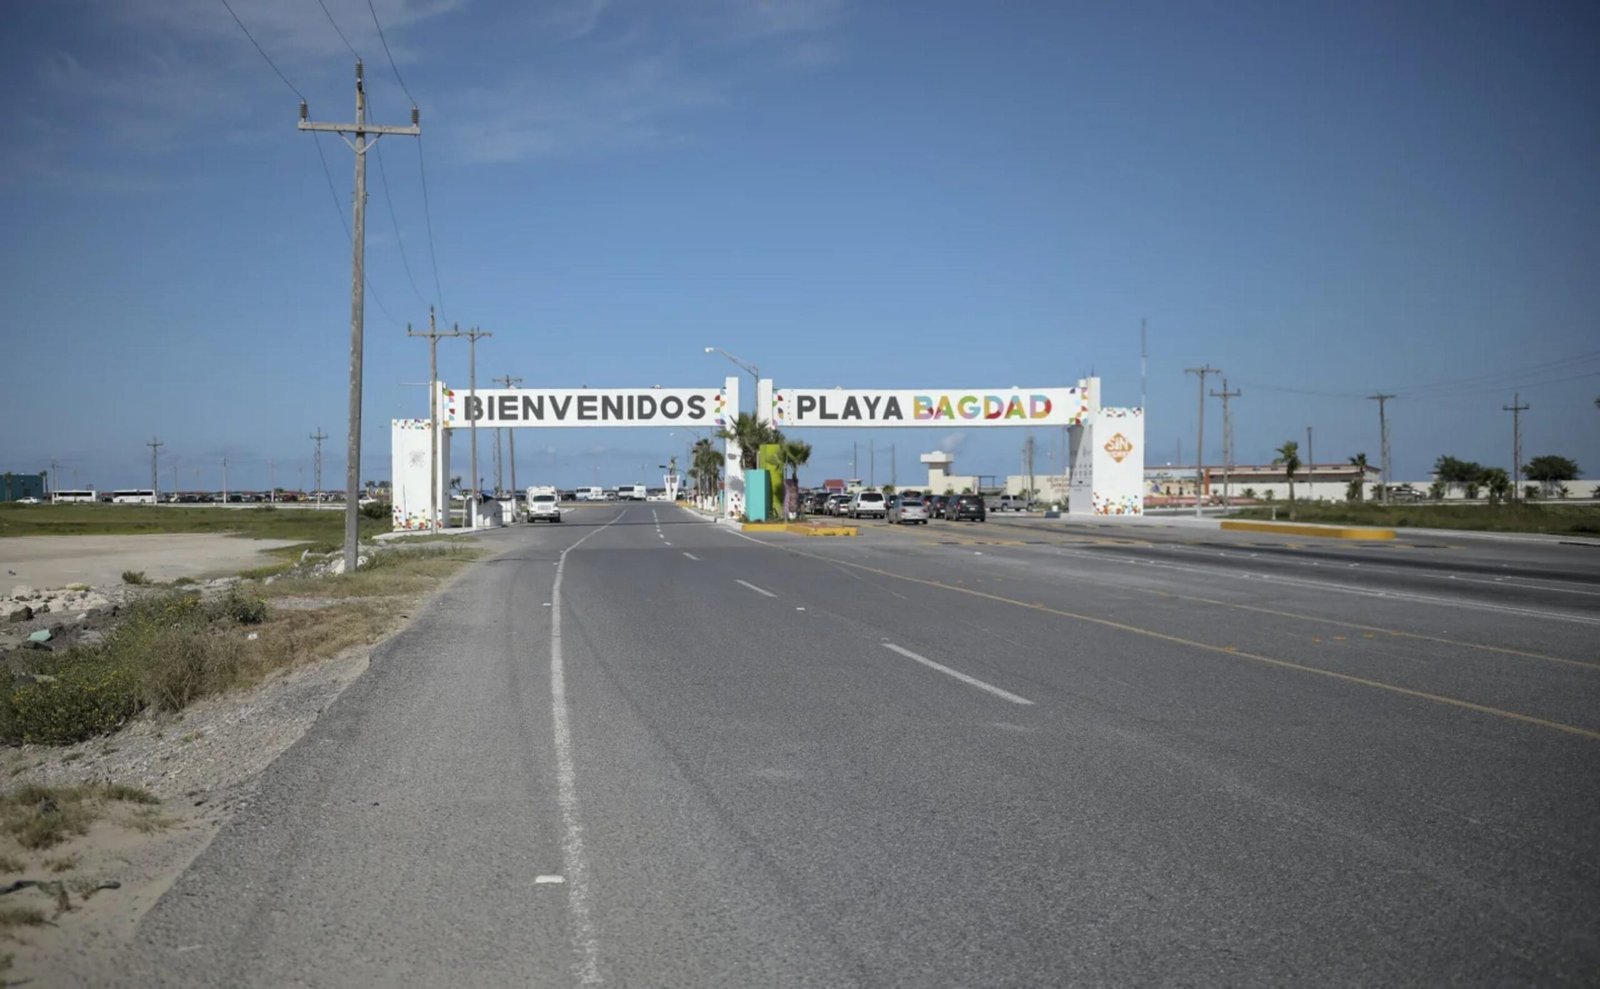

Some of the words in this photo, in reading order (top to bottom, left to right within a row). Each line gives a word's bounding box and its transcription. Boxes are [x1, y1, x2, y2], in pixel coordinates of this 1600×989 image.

[465, 395, 706, 421] BIENVENIDOS
[797, 395, 903, 420] PLAYA
[913, 394, 1052, 420] BAGDAD
